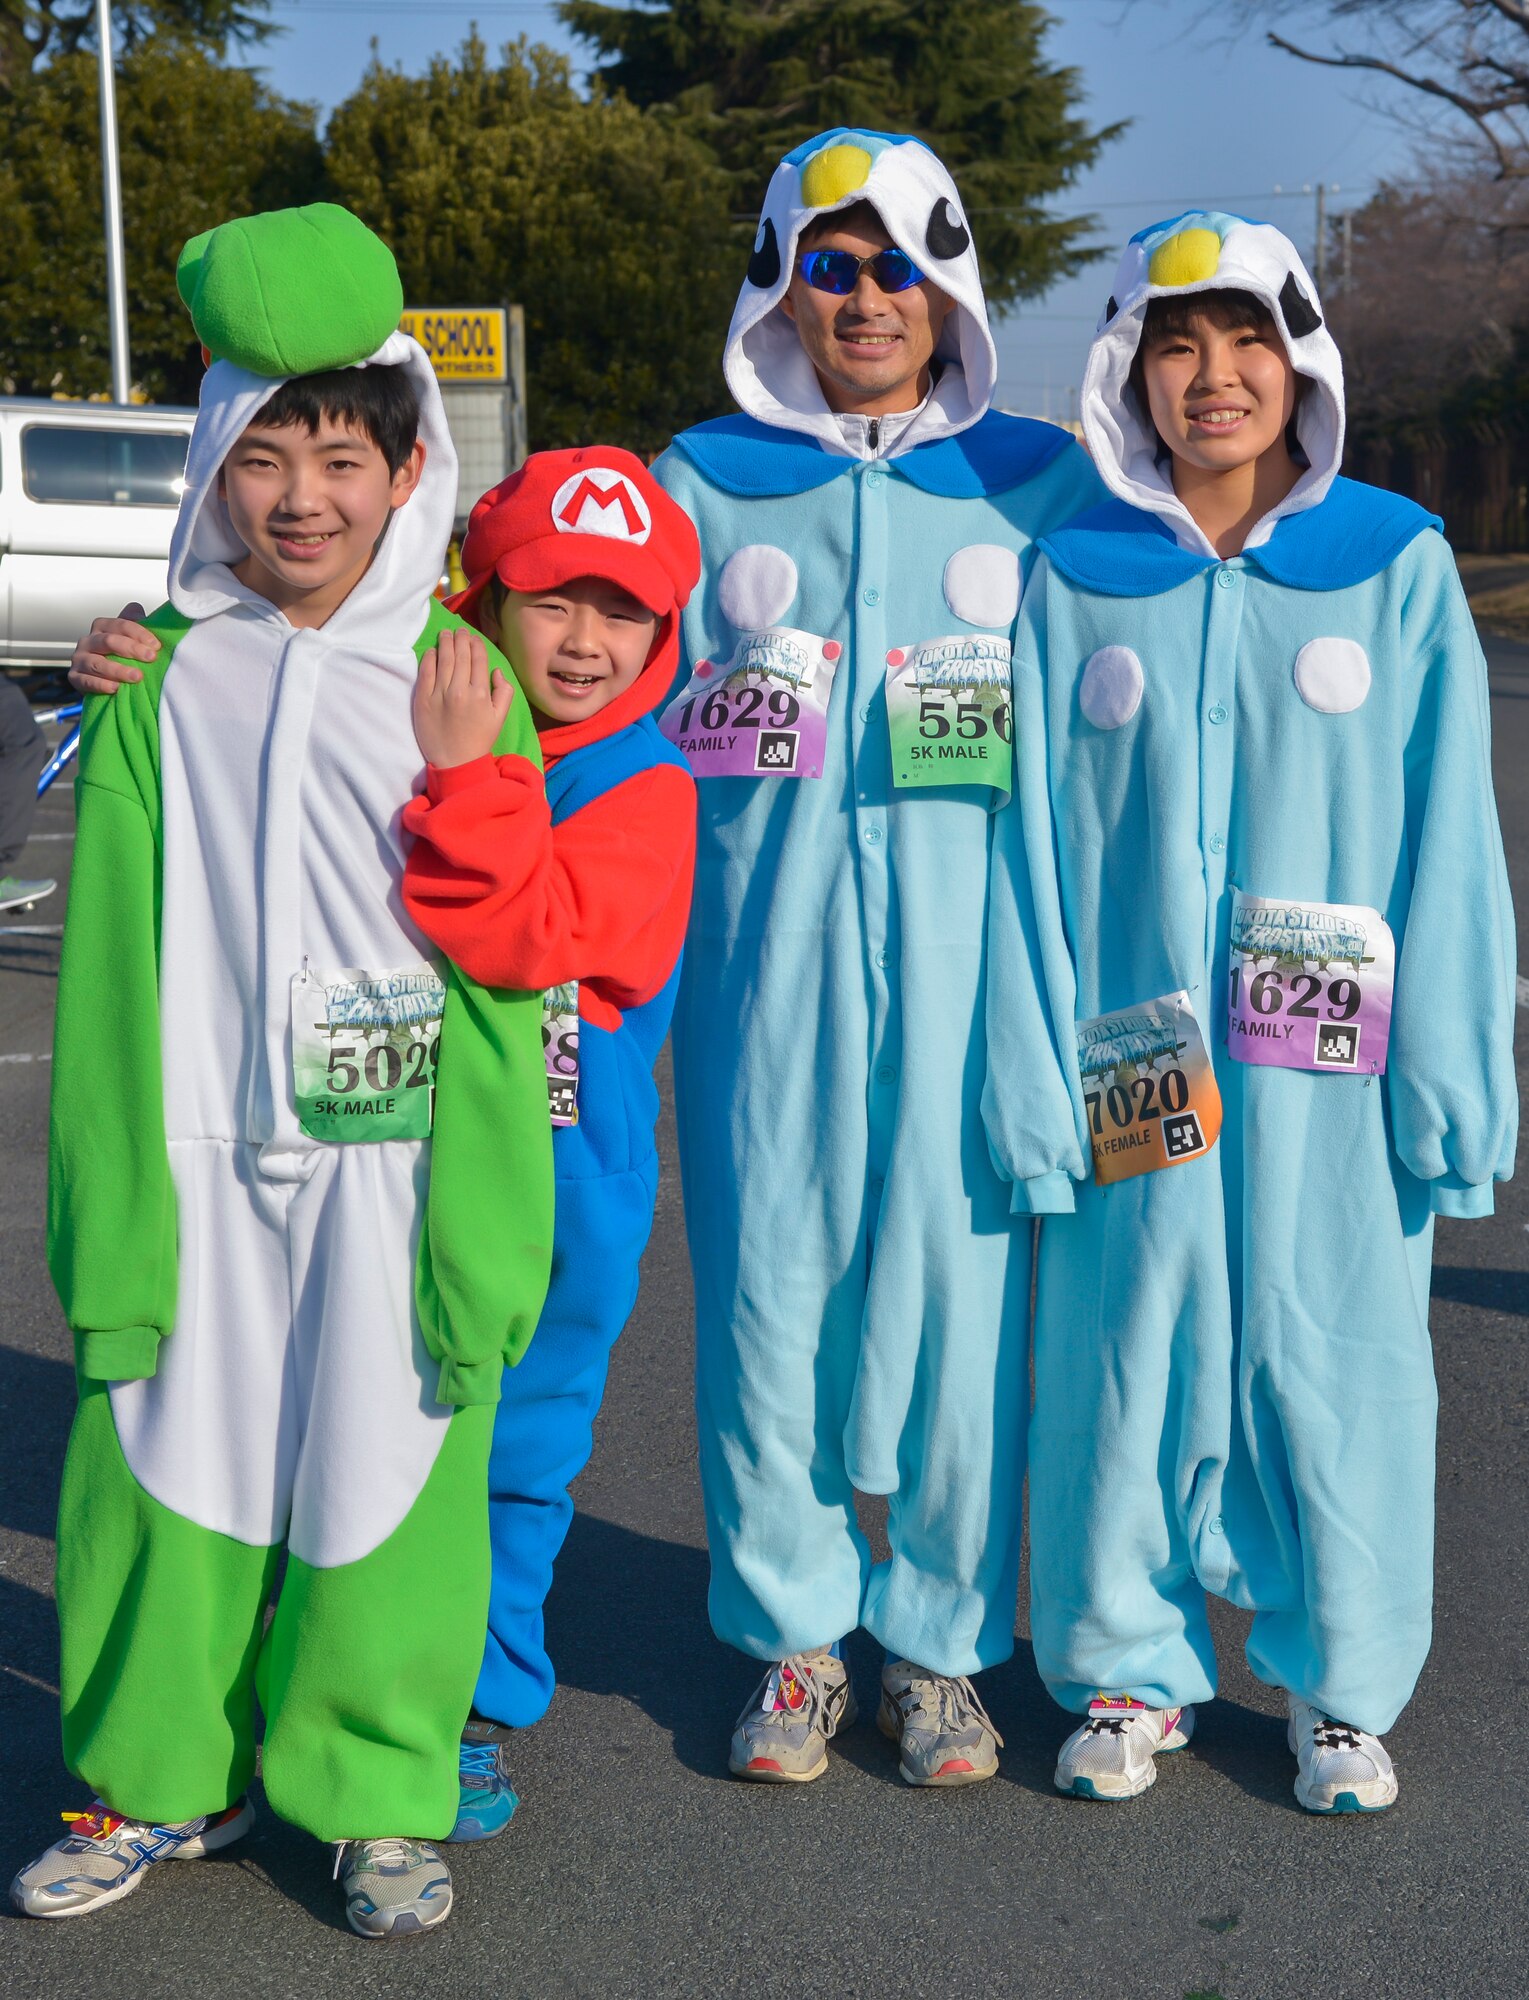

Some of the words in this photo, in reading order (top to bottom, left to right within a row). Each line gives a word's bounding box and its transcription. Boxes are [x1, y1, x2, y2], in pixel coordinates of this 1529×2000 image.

[424, 317, 494, 355] SCHOOL
[559, 475, 646, 536] M
[914, 641, 977, 668] YOKOTA
[679, 688, 800, 734] 1629
[680, 736, 737, 752] FAMILY
[911, 746, 934, 759] 5K
[938, 746, 988, 759] MALE
[1287, 907, 1366, 941] STRIDERS
[1230, 967, 1361, 1020] 1629
[1232, 1018, 1294, 1039] FAMILY
[314, 1101, 339, 1115] 5K
[344, 1099, 395, 1115] MALE
[1085, 1069, 1188, 1135] 7020
[1105, 1129, 1151, 1155] FEMALE
